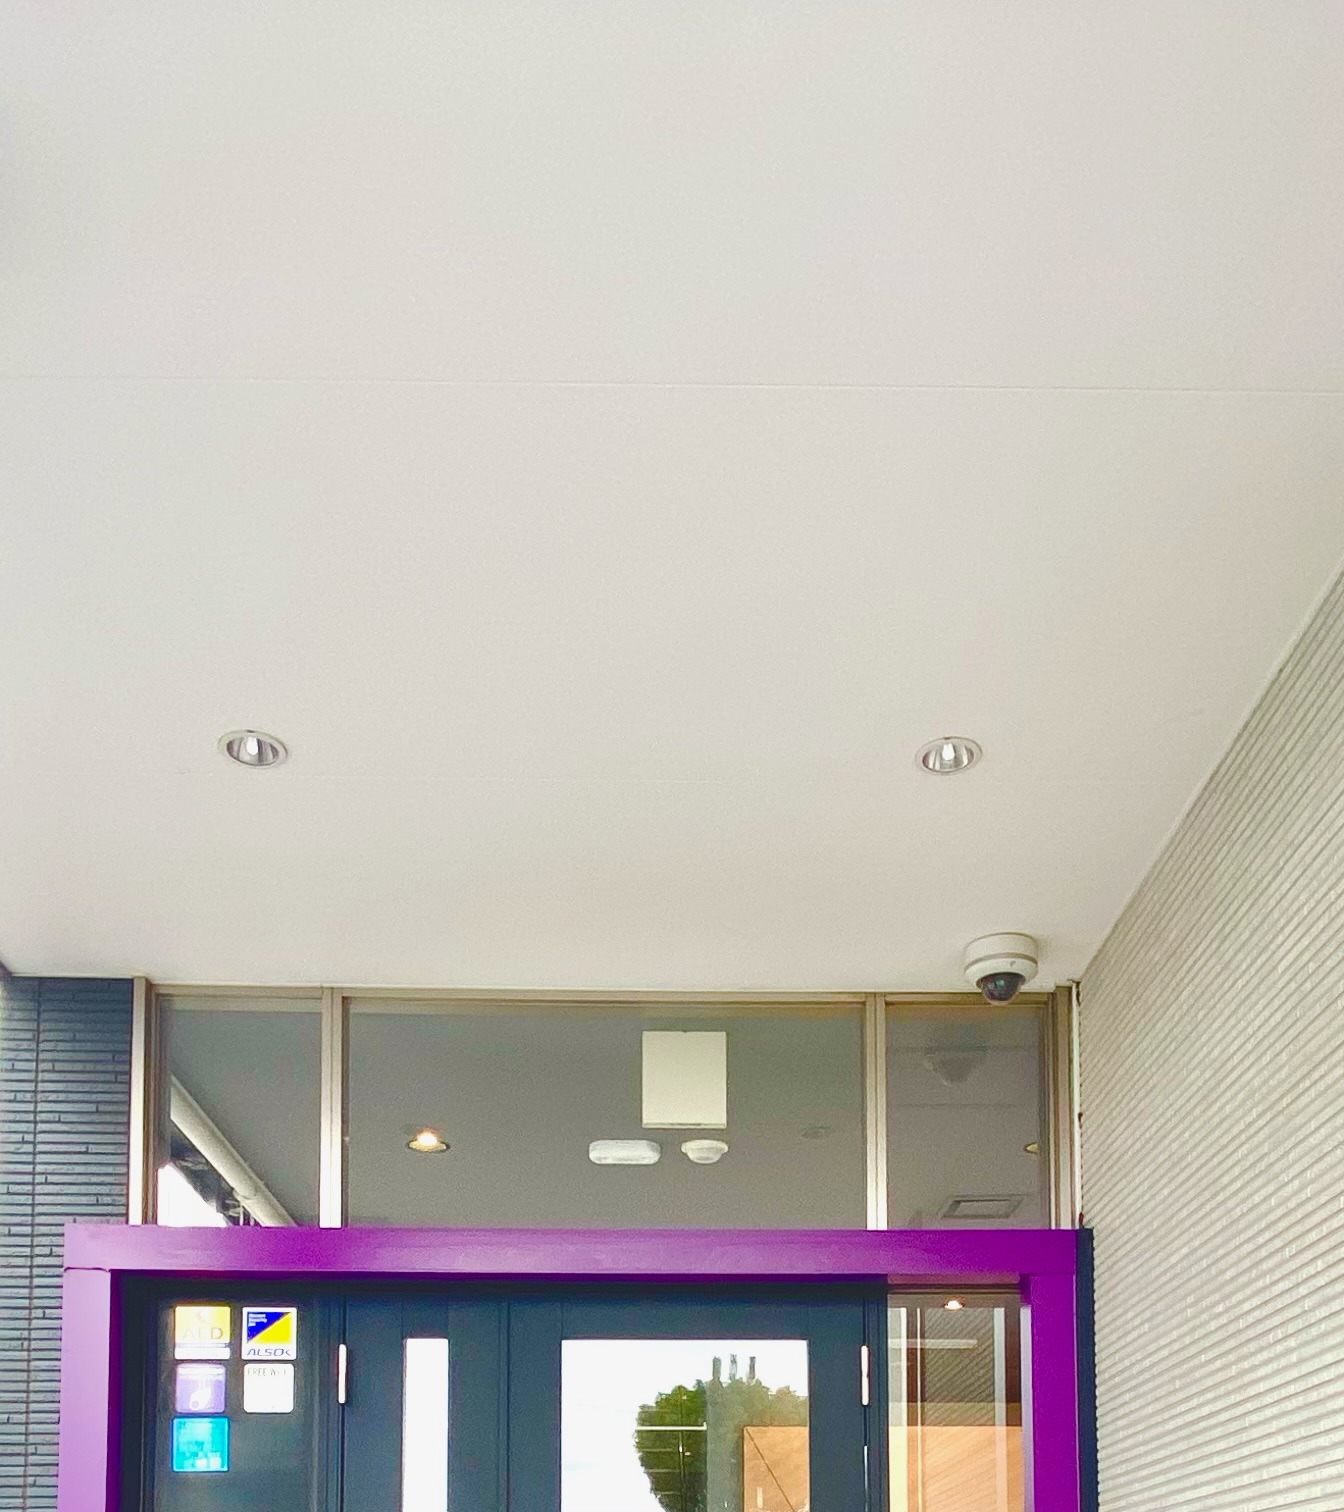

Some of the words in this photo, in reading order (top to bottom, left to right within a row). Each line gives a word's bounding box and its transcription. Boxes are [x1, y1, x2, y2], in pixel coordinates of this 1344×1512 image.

[182, 1327, 223, 1340] AED
[246, 1347, 292, 1357] ALSOK
[247, 1367, 267, 1377] FREE
